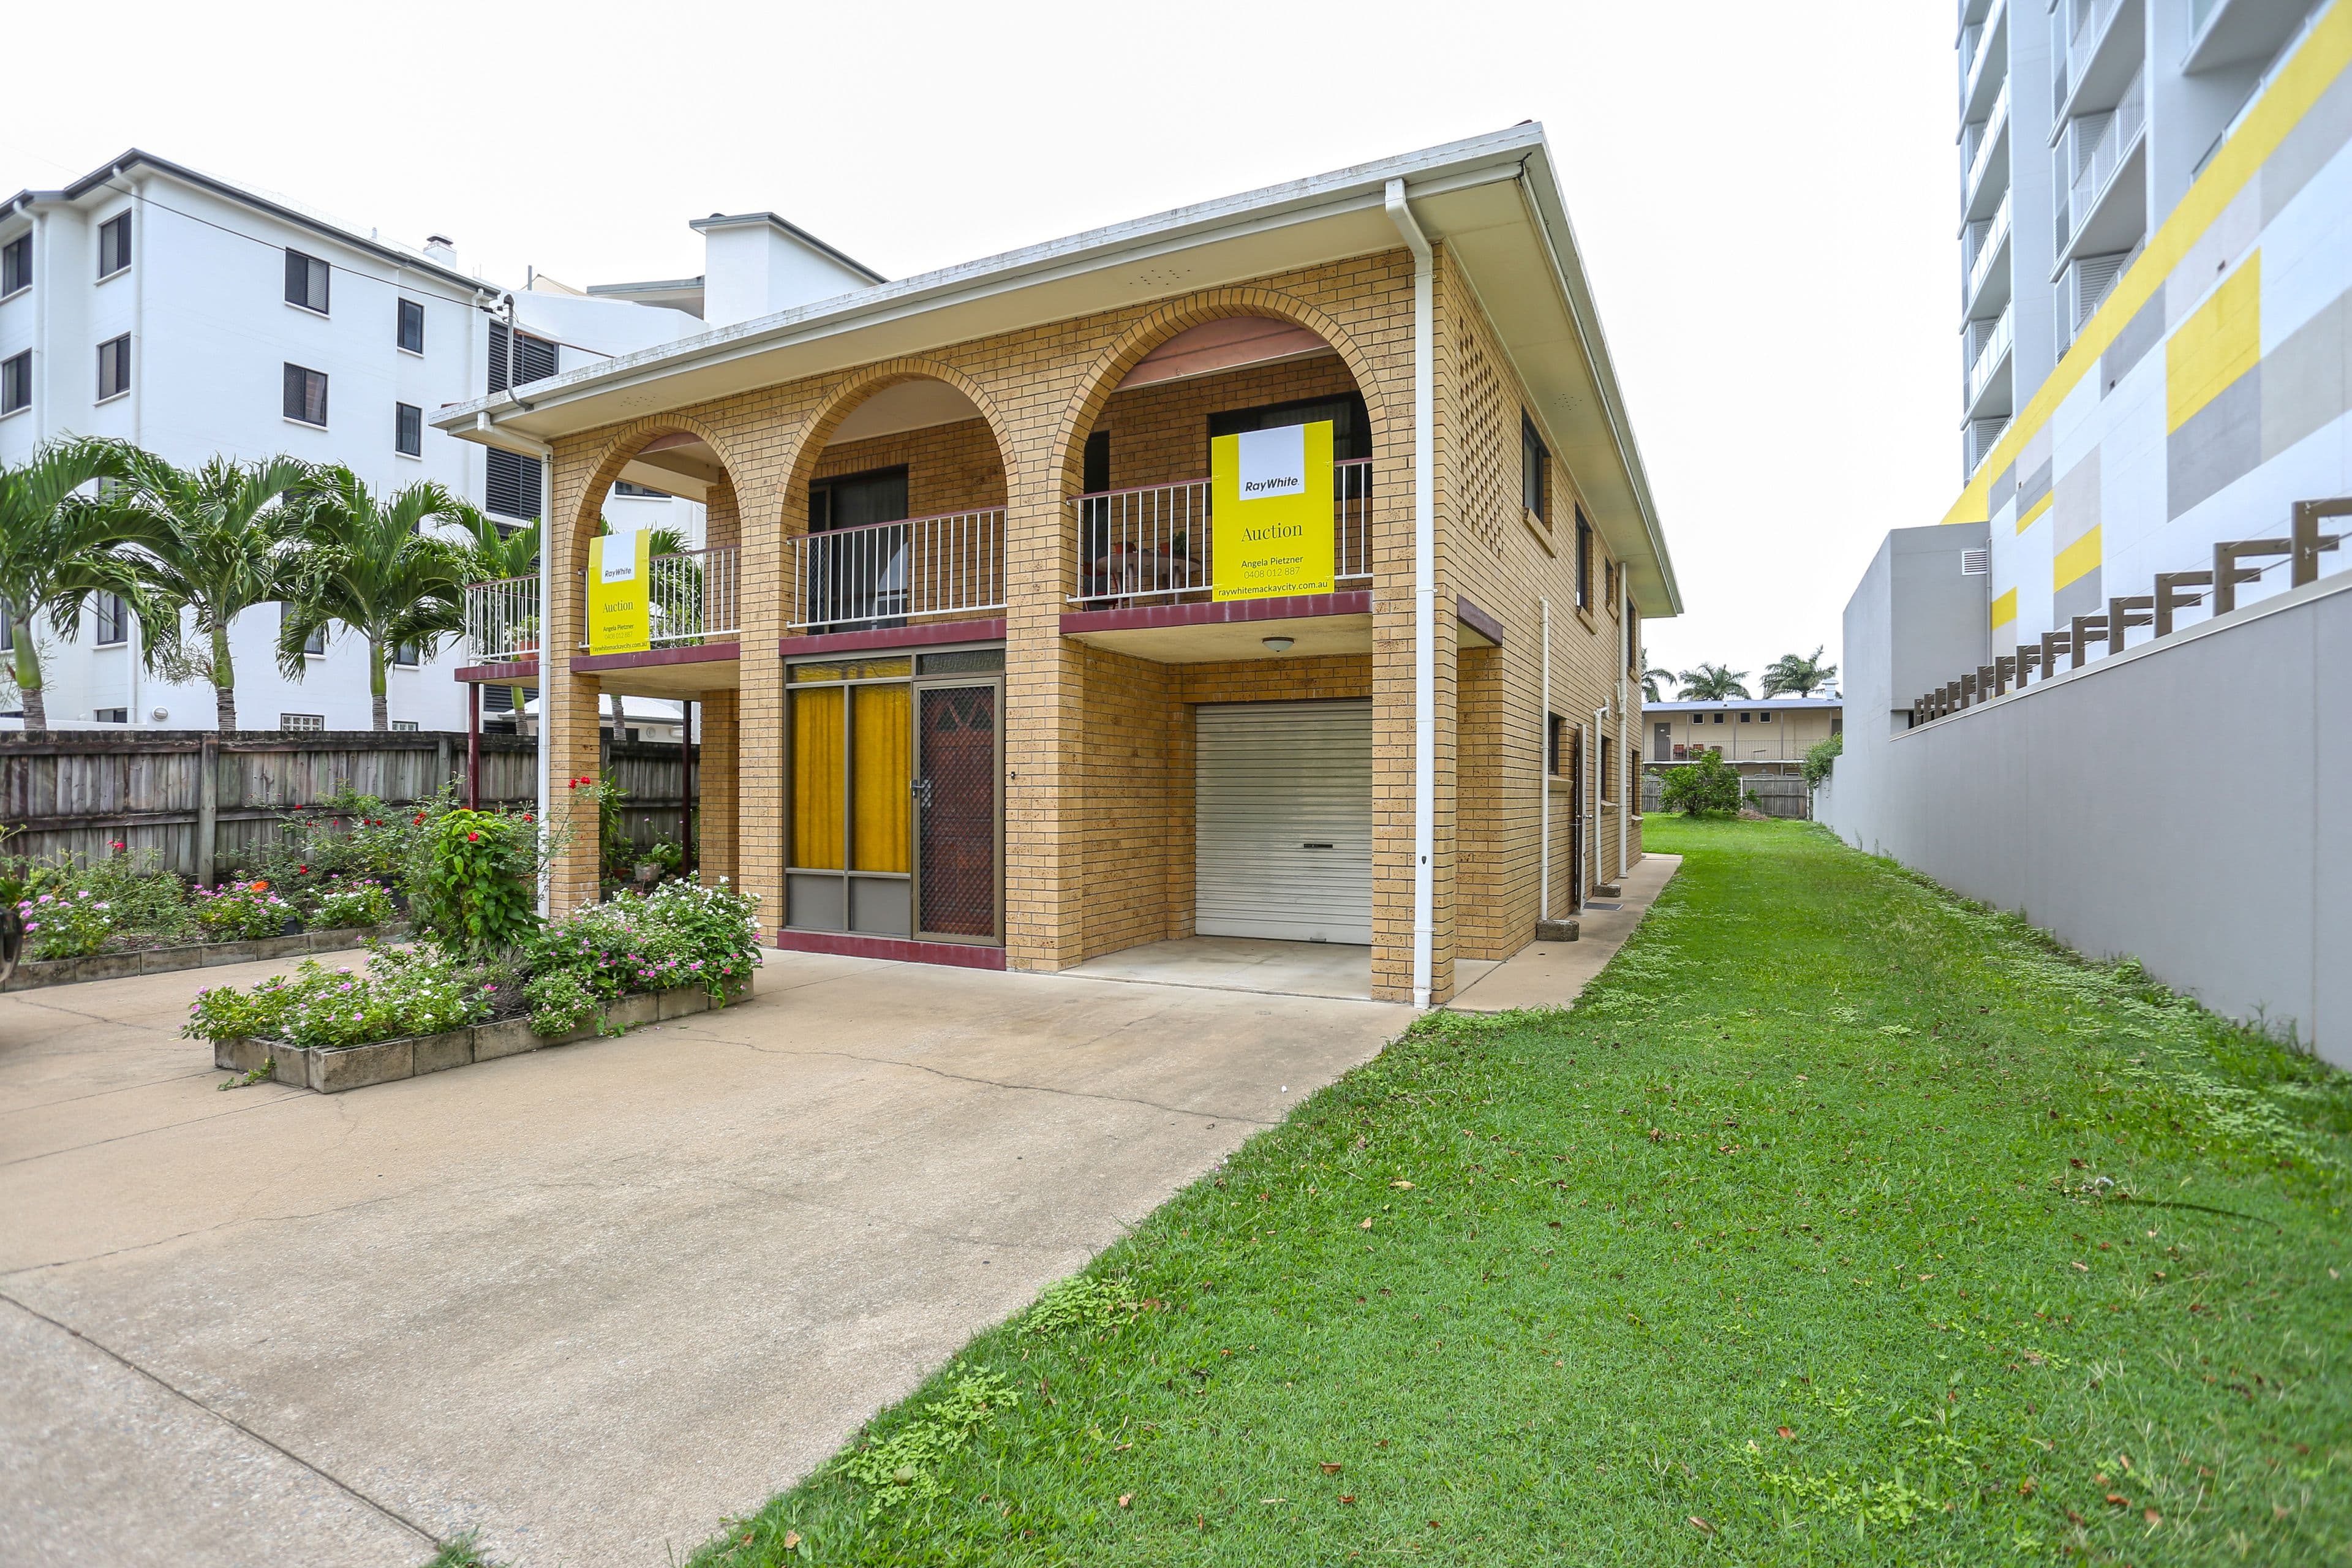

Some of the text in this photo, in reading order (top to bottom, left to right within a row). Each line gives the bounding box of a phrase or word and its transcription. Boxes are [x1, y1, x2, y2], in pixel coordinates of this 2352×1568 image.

[1241, 522, 1303, 541] Auction
[1241, 556, 1303, 568] Angela Pietzner
[1244, 567, 1300, 579] 0408 012 887
[1218, 581, 1328, 597] raywhitemackaycity.com.au
[603, 600, 633, 613] Auction
